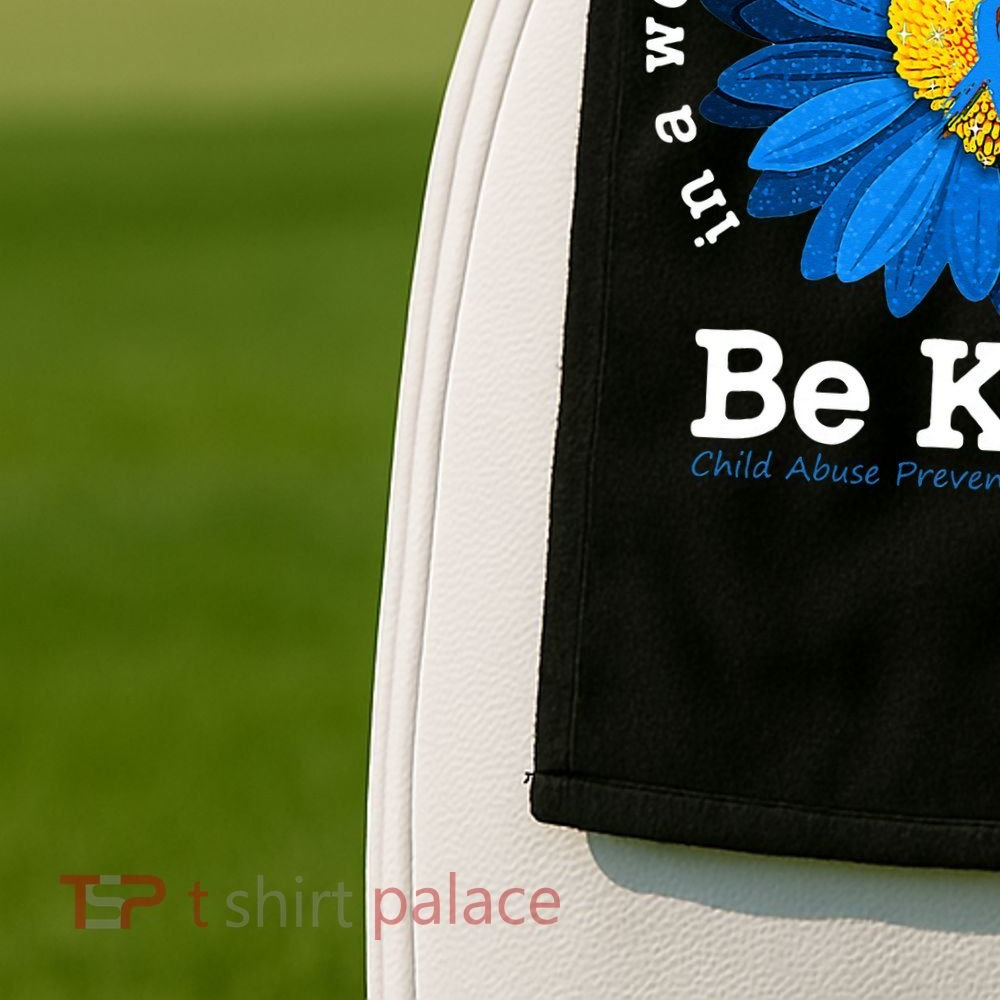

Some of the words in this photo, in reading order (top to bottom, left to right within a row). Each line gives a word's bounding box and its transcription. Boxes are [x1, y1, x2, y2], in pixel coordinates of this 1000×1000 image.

[655, 105, 698, 143] a
[681, 169, 741, 247] in
[690, 329, 870, 446] Be
[690, 450, 773, 479] Child
[785, 452, 880, 486] Abuse
